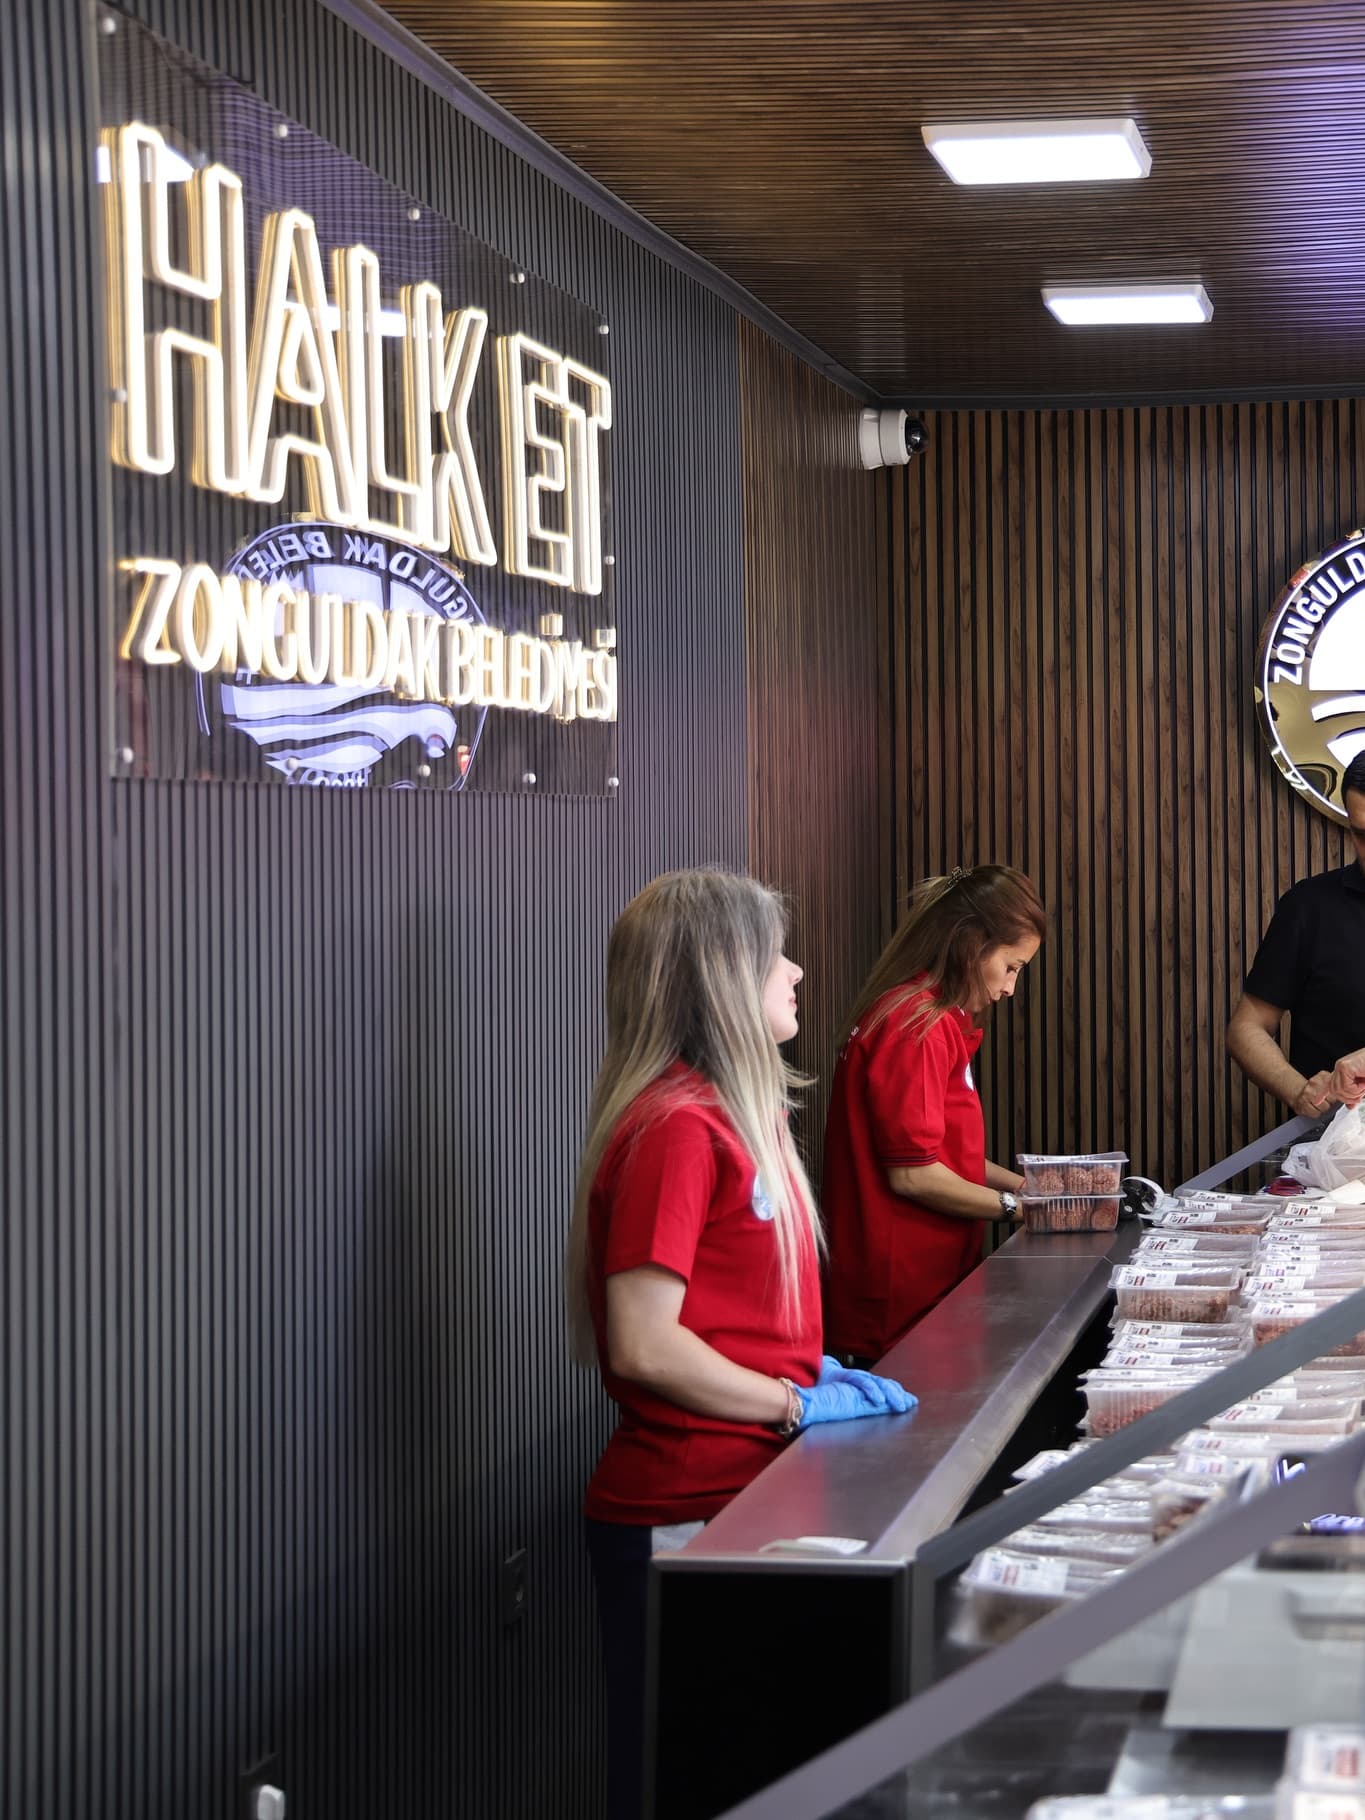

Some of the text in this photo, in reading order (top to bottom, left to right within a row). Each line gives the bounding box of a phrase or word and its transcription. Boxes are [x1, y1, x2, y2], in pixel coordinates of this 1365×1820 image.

[103, 119, 612, 595] HALK ET
[120, 558, 618, 724] ZONGULDAK BELEDİYESİ
